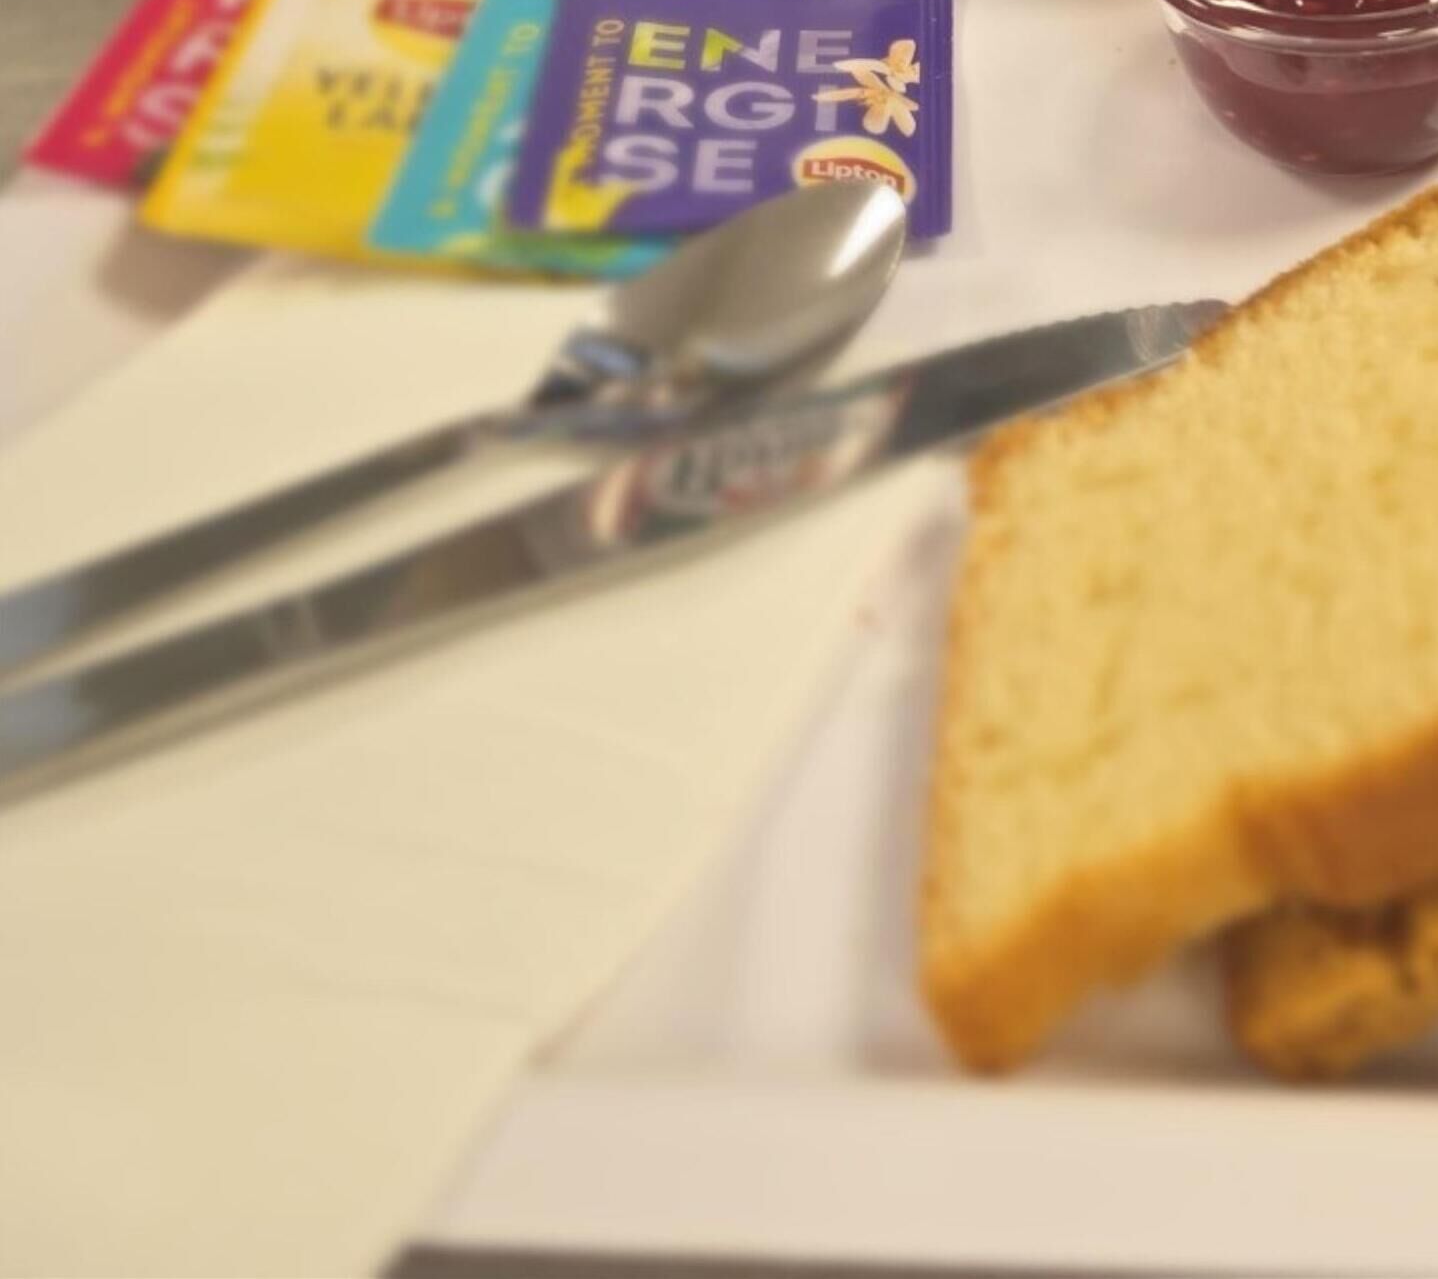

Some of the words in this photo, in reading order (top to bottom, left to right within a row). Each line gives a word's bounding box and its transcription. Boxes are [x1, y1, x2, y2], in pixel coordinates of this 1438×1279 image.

[627, 20, 854, 74] ENE
[603, 133, 759, 194] SE
[810, 160, 897, 187] Lipton
